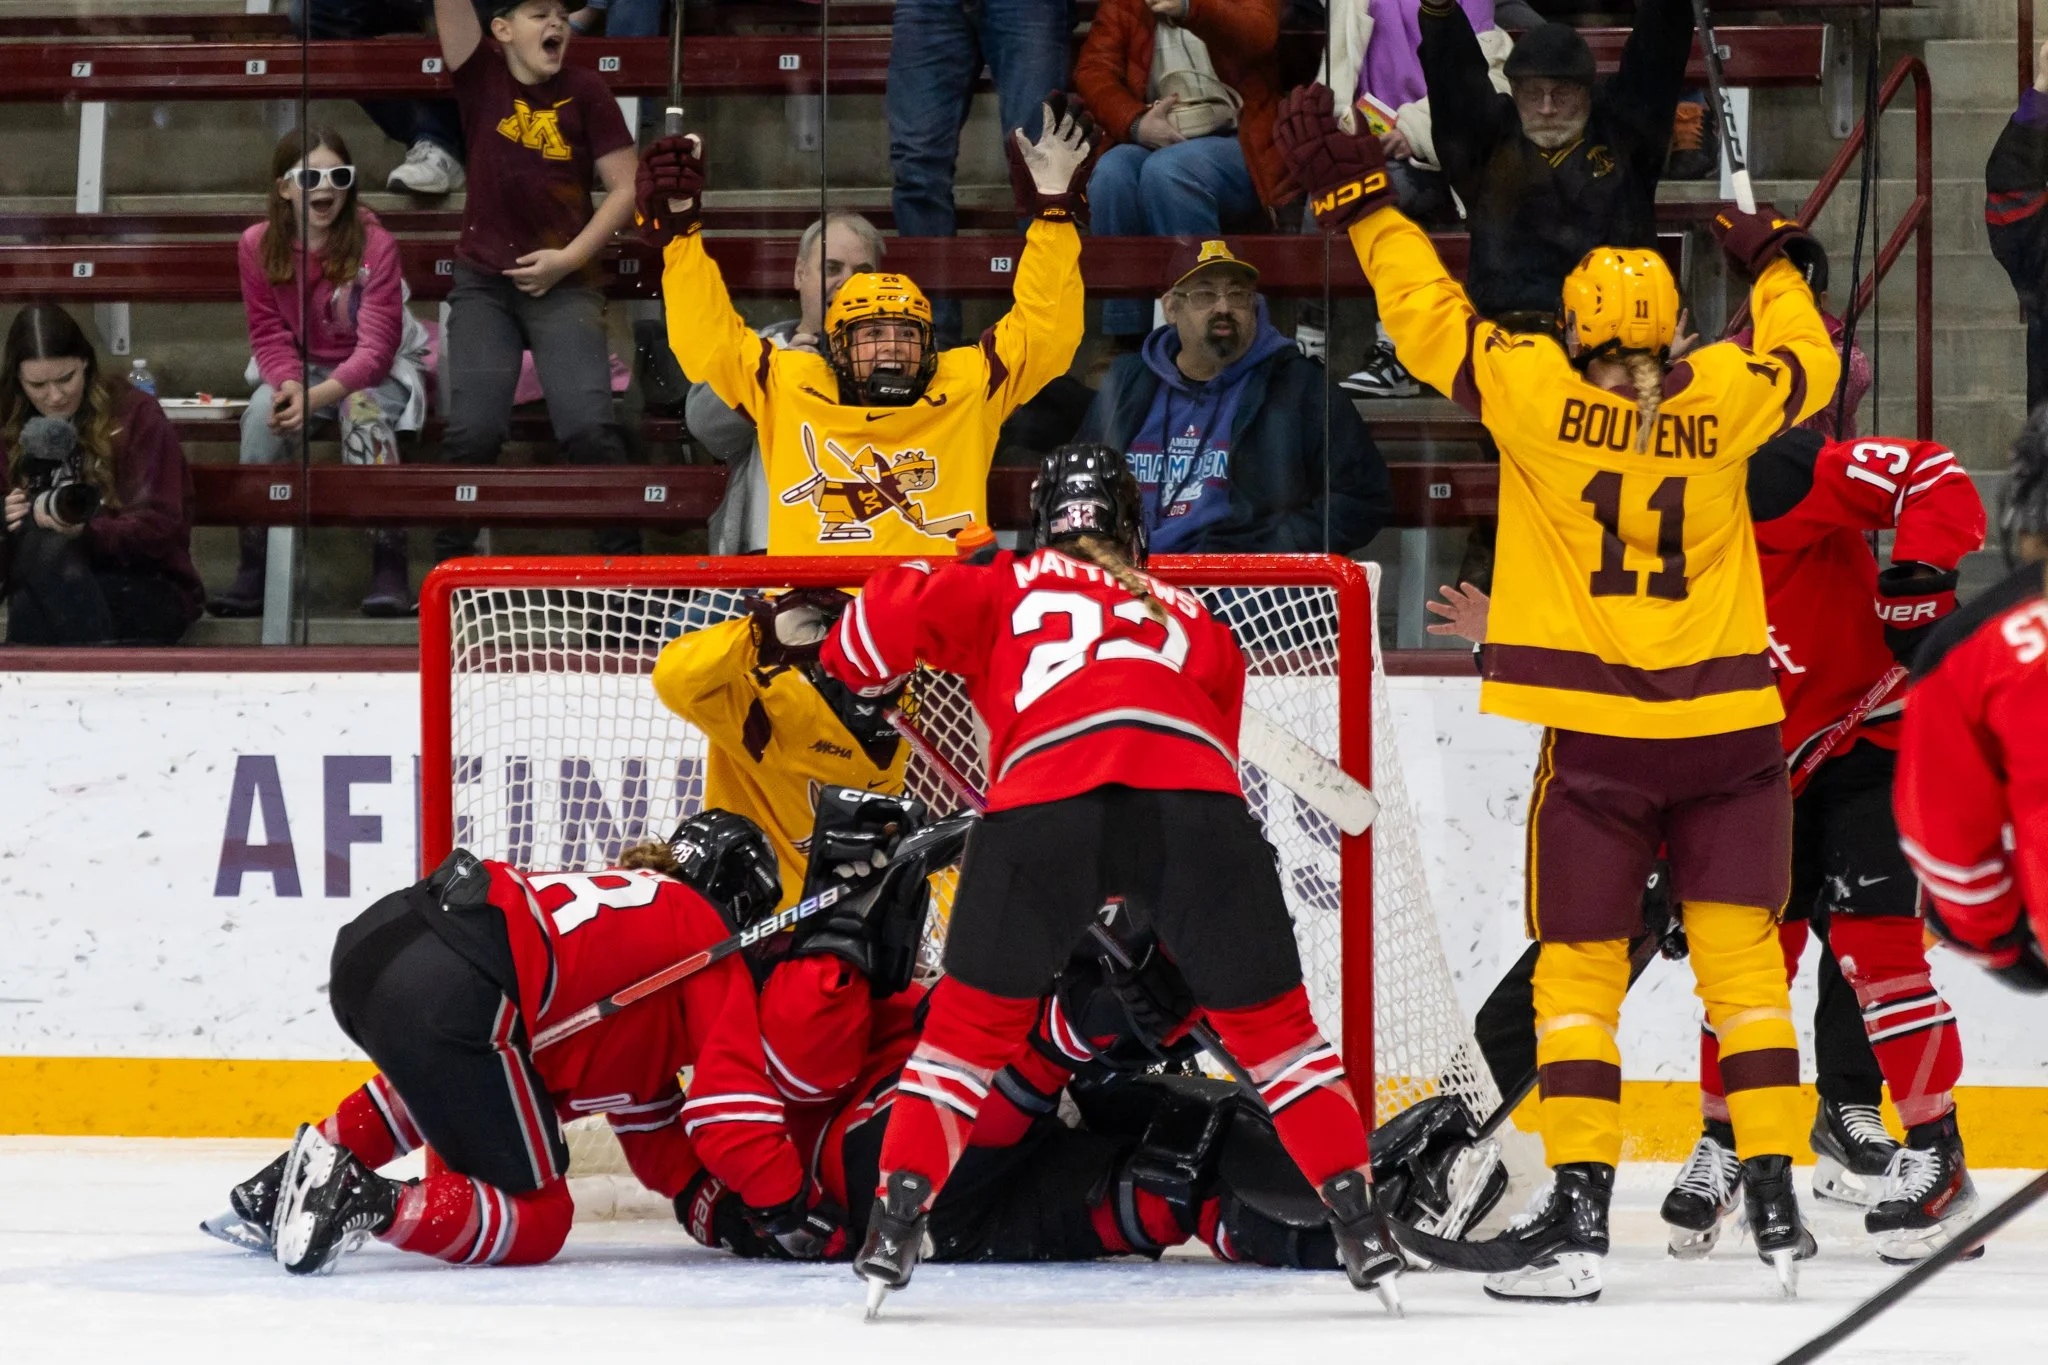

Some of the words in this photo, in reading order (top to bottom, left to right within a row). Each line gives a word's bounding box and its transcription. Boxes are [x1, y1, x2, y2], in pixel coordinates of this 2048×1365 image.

[251, 62, 259, 73] 8
[427, 61, 435, 71] 9
[602, 59, 616, 69] 10
[783, 56, 794, 68] 11
[77, 64, 85, 75] 7
[1309, 171, 1388, 217] CCM
[79, 264, 86, 276] 8
[994, 259, 1009, 271] 13
[1635, 299, 1649, 319] 11
[879, 386, 912, 396] CCM
[1845, 441, 1911, 495] 13
[272, 485, 288, 499] 10
[460, 487, 472, 500] 11
[648, 488, 662, 501] 12
[1433, 485, 1448, 498] 16
[857, 488, 884, 516] M
[1580, 469, 1690, 602] 11
[740, 886, 838, 948] BAUER
